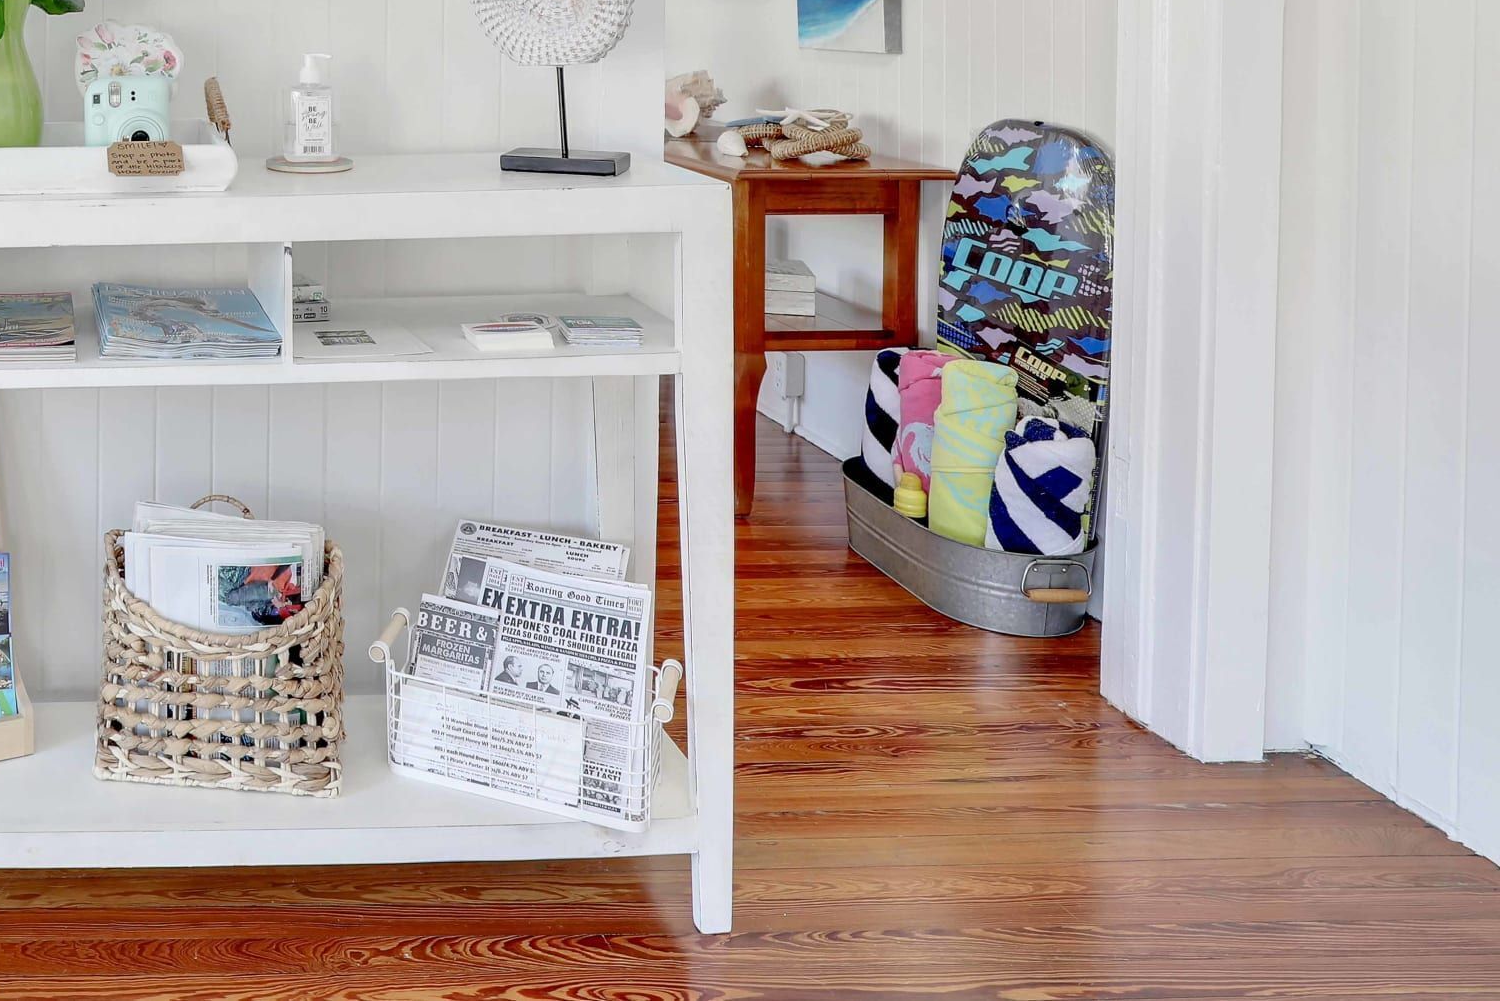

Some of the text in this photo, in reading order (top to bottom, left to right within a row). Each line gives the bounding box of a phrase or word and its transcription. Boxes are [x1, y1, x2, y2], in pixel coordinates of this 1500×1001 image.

[479, 525, 619, 552] BREAKFAST LUNCH BAKERY
[525, 581, 625, 609] Roaring Good Times
[418, 611, 487, 641] BEER &
[505, 596, 641, 641] EXTRA EXTRA!
[436, 639, 470, 654] FROZEN
[502, 627, 637, 661] PIZZA SO GOOD IT SHOULD BE ILLEGAL!
[504, 615, 638, 653] CAPONE'S COAL FIRED PIZZA
[422, 643, 480, 665] MARGARITAS
